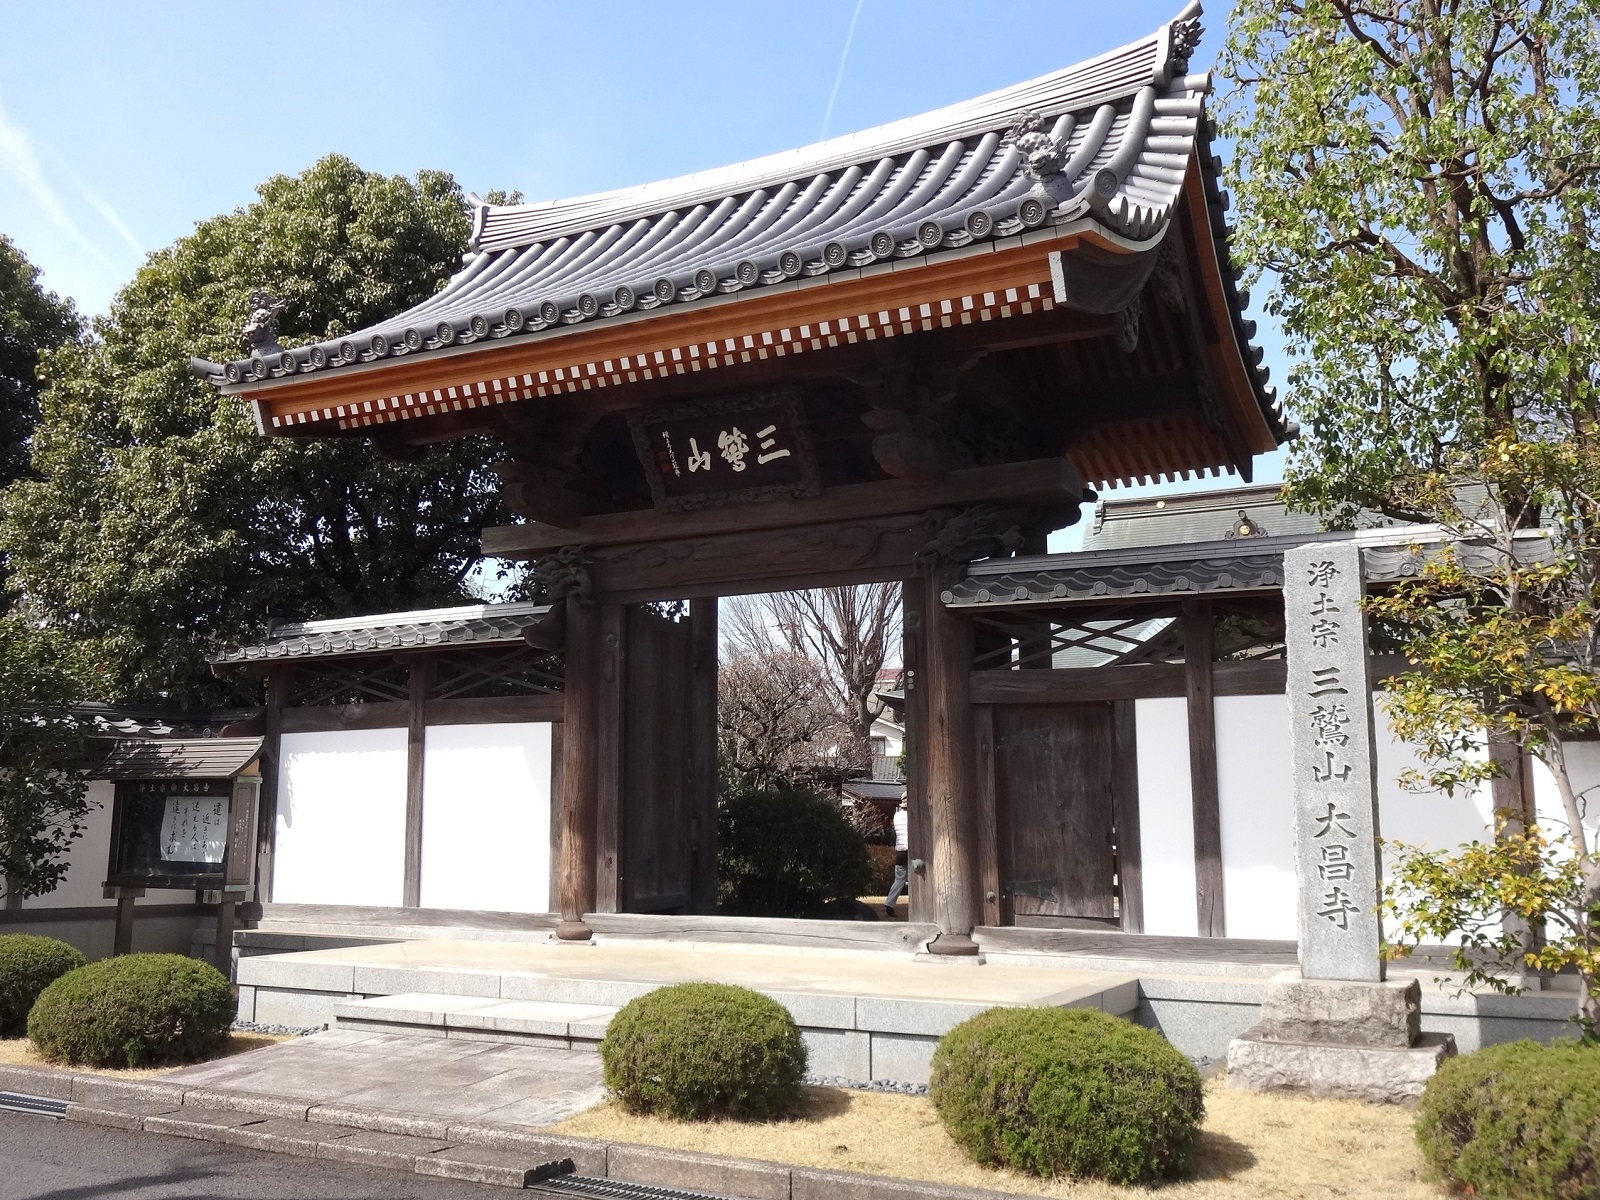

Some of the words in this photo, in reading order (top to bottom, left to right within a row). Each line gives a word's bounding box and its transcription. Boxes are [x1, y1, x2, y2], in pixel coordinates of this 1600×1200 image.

[1307, 560, 1342, 649] 浄土宗
[1307, 666, 1352, 785] 三鷲山
[212, 802, 222, 826] 道は
[1313, 801, 1361, 932] 大昌寺
